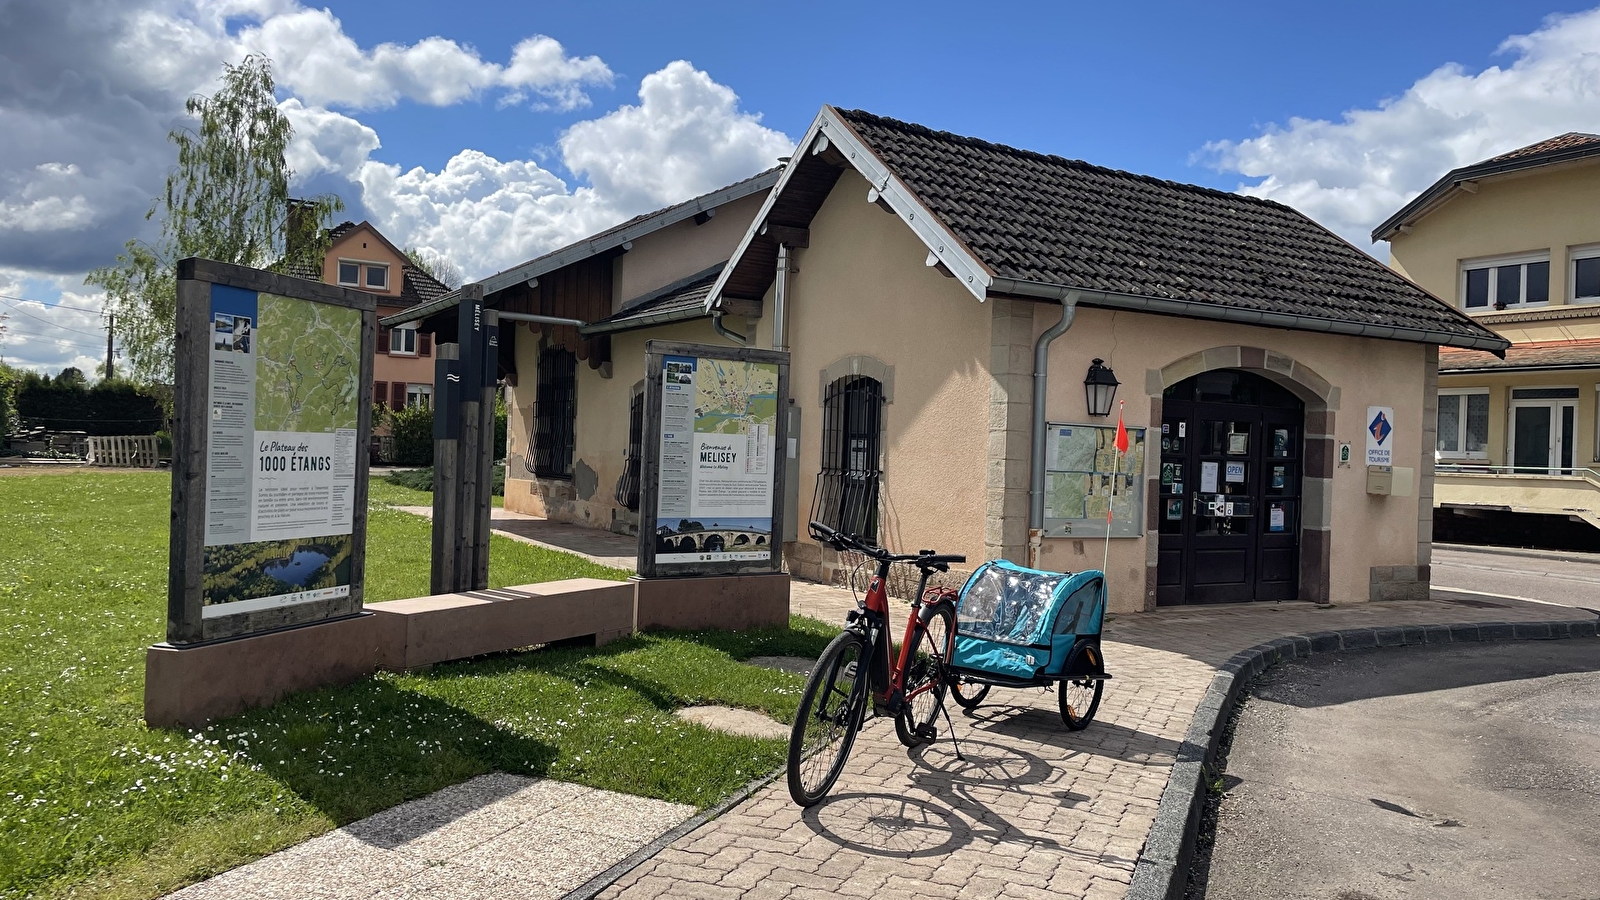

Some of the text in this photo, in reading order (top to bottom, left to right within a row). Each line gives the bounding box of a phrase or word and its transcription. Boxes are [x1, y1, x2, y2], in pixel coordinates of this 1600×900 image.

[260, 440, 309, 452] Le Plateau des
[700, 442, 726, 450] Bienvenue
[260, 456, 286, 472] 1000
[291, 452, 331, 471] ÉTANGS
[700, 452, 737, 463] MELISEY
